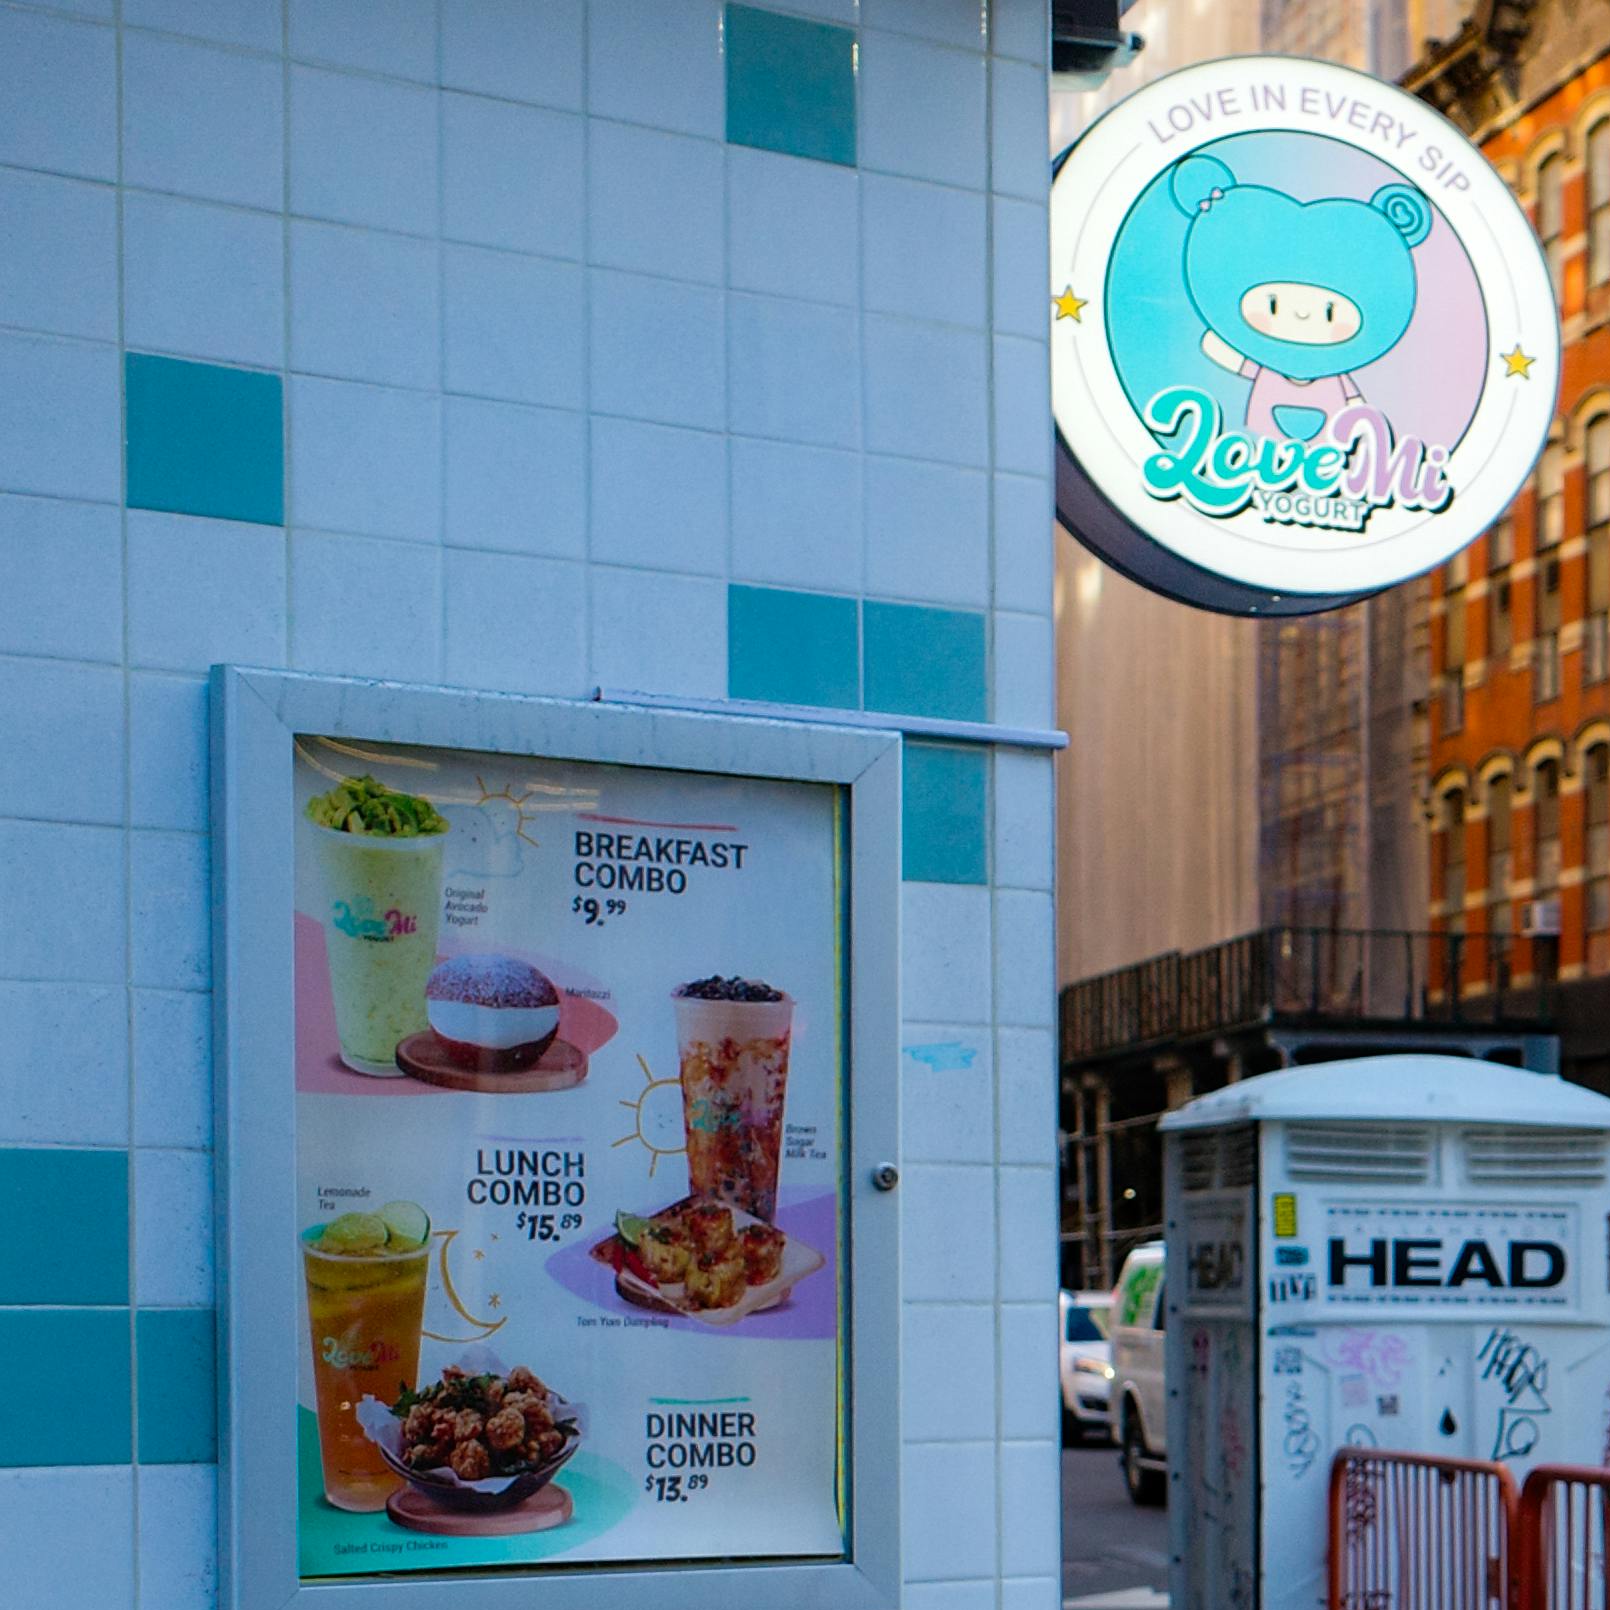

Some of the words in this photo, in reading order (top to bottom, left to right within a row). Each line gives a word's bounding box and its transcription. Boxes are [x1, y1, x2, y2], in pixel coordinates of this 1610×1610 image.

[1147, 86, 1242, 145] LOVE
[1250, 84, 1287, 111] IN
[1300, 87, 1417, 149] EVERY
[1418, 144, 1471, 194] SIP
[1260, 494, 1363, 523] YOGURT
[575, 831, 749, 870] BREAKFAST
[575, 862, 687, 894] COMBO
[445, 887, 485, 901] Original
[445, 901, 488, 914] Avocado
[445, 913, 479, 926] Yogurt
[477, 1149, 585, 1178] LUNCH
[317, 1184, 371, 1198] Lemonade
[319, 1199, 336, 1210] Tea
[467, 1179, 585, 1207] COMBO
[1328, 1238, 1567, 1288] HEAD
[646, 1412, 756, 1439] DINNER
[646, 1442, 756, 1468] COMBO
